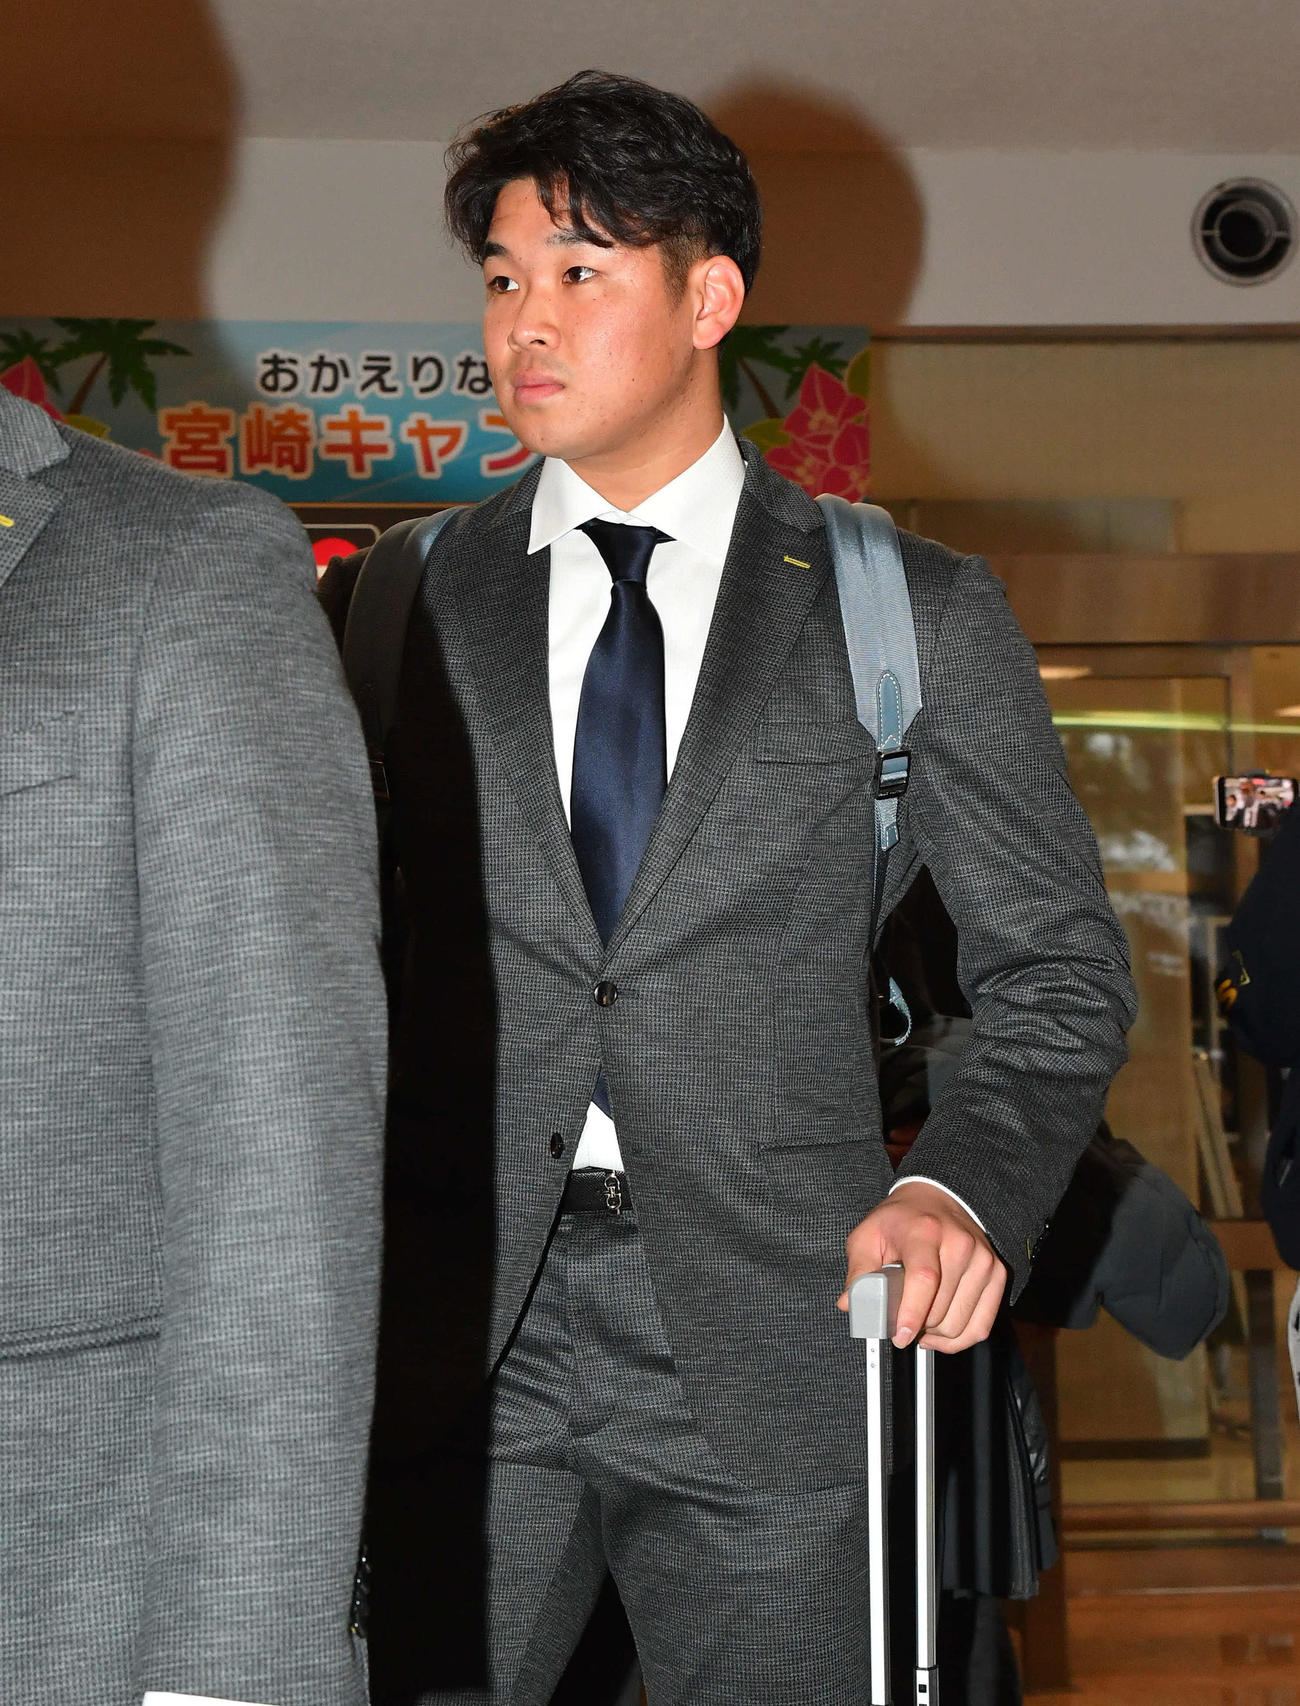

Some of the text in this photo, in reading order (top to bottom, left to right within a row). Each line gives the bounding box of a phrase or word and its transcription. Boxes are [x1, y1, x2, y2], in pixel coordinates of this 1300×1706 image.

[259, 353, 493, 395] おかえりな
